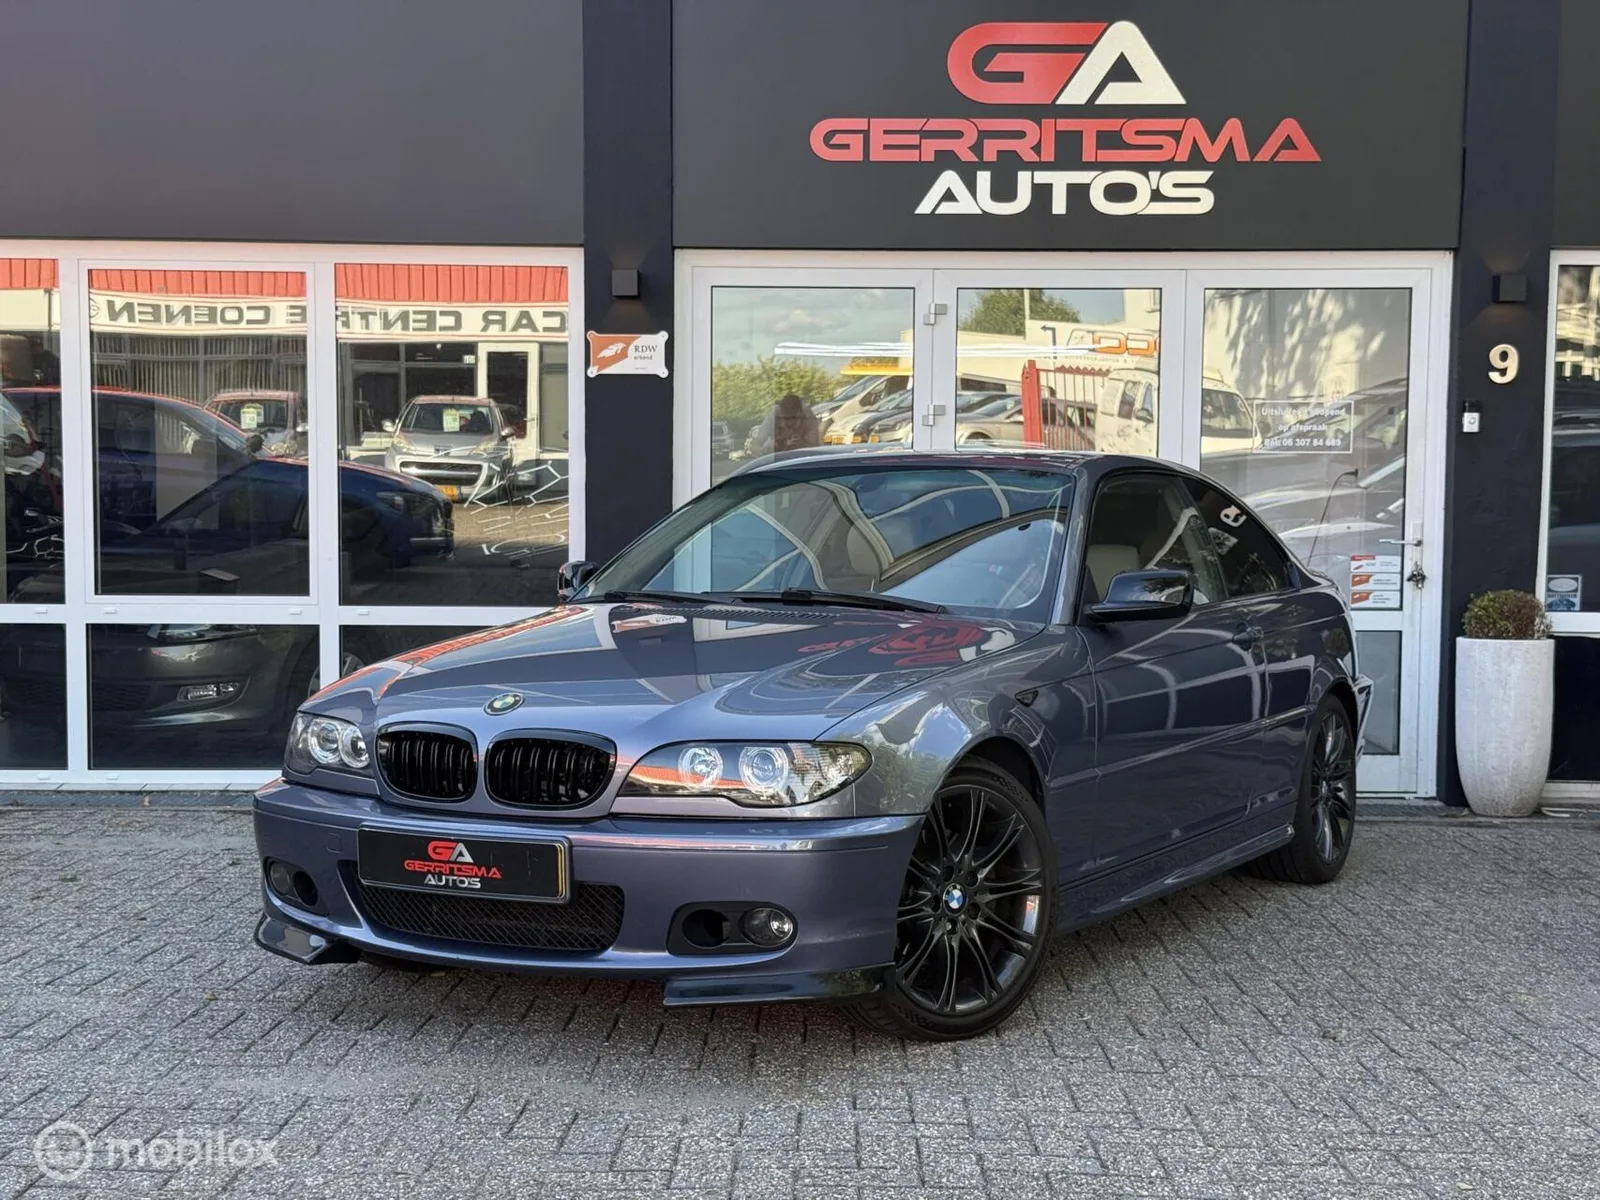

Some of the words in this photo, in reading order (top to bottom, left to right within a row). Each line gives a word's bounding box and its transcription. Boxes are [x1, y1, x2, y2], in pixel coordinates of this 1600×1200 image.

[947, 20, 1187, 105] GA
[809, 117, 1322, 163] GERRITSMA
[914, 169, 1215, 216] AUTO'S
[633, 344, 658, 354] RDW
[1488, 343, 1519, 384] 9
[1290, 422, 1328, 432] afspraak
[1282, 438, 1293, 447] 06
[1294, 438, 1311, 447] 307
[427, 840, 475, 863] GA
[404, 859, 502, 879] GERRITSMA
[424, 873, 481, 889] AUTO'S
